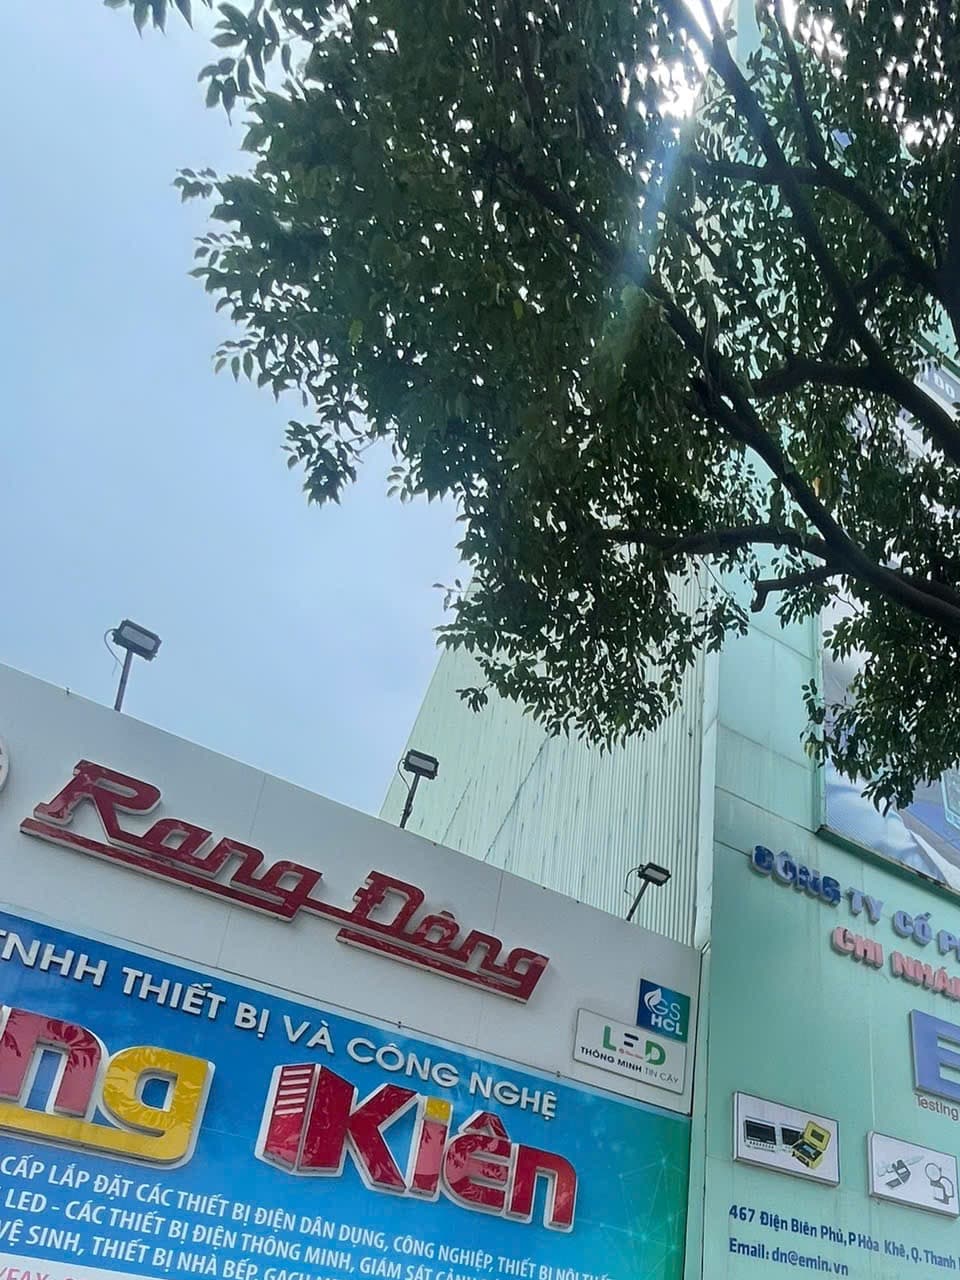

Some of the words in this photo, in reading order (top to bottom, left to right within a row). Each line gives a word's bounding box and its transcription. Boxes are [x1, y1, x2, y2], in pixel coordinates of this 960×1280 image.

[846, 887, 885, 923] TY
[831, 926, 884, 969] CHI
[121, 966, 227, 1020] THIẾT
[234, 1002, 270, 1040] BỊ
[283, 1014, 335, 1054] VÀ
[347, 1037, 459, 1087] CÔNG
[469, 1071, 557, 1120] NGHỆ
[651, 1013, 683, 1036] HCL
[580, 1046, 615, 1064] THÔNG
[617, 1059, 642, 1073] MINH
[645, 1067, 657, 1078] TIN
[914, 1094, 959, 1121] Testing
[260, 1062, 578, 1233] Kiên
[1, 1155, 45, 1180] CẤP
[48, 1163, 90, 1189] LẮP
[93, 1174, 134, 1200] ĐẶT
[136, 1183, 174, 1207] CÁC
[177, 1191, 229, 1217] THIẾT
[232, 1202, 251, 1227] BỊ
[254, 1207, 297, 1233] ĐIỆN
[300, 1216, 335, 1240] DÂN
[338, 1224, 389, 1252] DỤNG,
[393, 1235, 435, 1259] CÔNG
[439, 1244, 495, 1272] NGHIỆP,
[497, 1256, 537, 1280] THIẾT
[5, 1188, 47, 1213] LED
[65, 1200, 105, 1225] CÁC
[110, 1207, 166, 1235] THIẾT
[168, 1220, 189, 1245] BỊ
[193, 1224, 237, 1250] ĐIỆN
[241, 1233, 301, 1261] THÔNG
[304, 1246, 355, 1273] MINH,
[360, 1257, 401, 1280] GIÁM
[729, 1205, 755, 1223] 467
[760, 1211, 788, 1232] Điện
[791, 1218, 817, 1237] Biên
[923, 1250, 956, 1270] Thanh
[26, 1225, 85, 1256] SINH,
[92, 1236, 150, 1264] THIẾT
[152, 1247, 173, 1272] BỊ
[177, 1251, 217, 1276] NHÀ
[729, 1237, 769, 1260] Email:
[771, 1247, 849, 1276] dn@emin.vn
